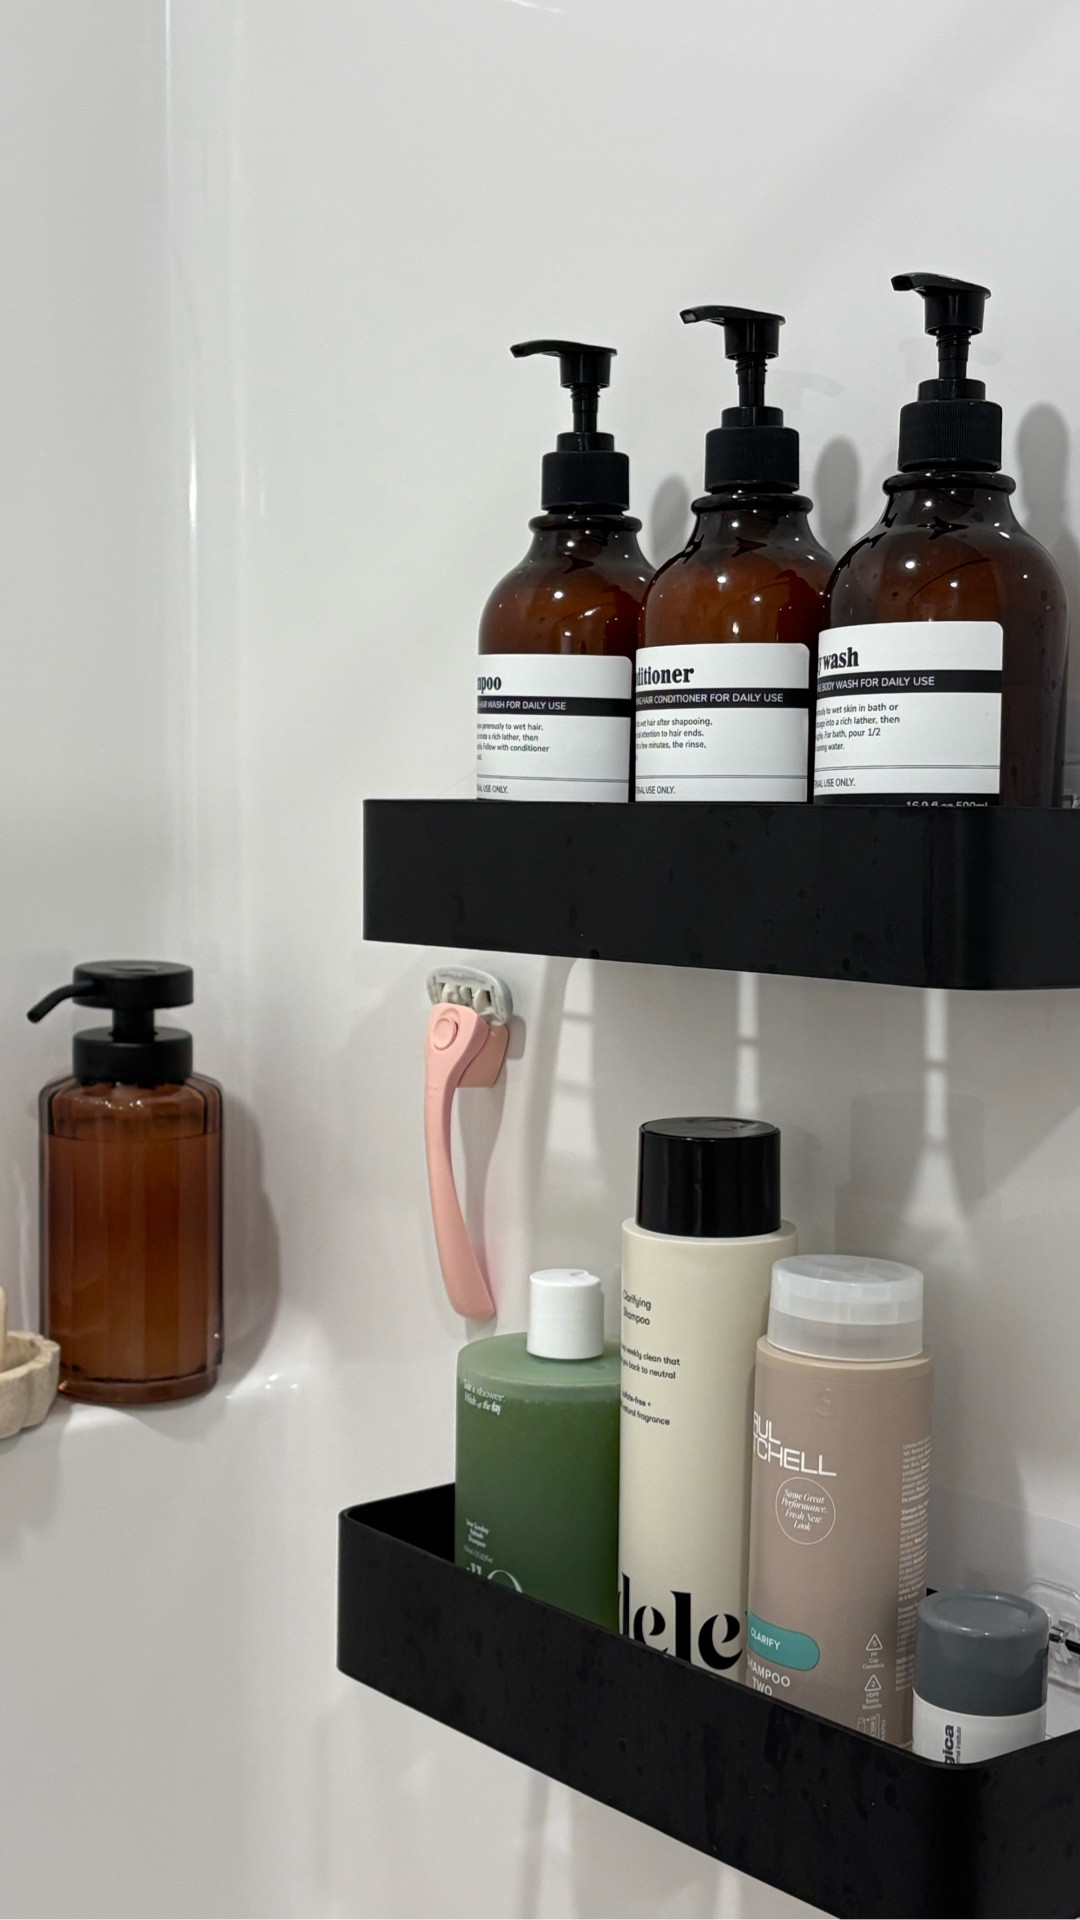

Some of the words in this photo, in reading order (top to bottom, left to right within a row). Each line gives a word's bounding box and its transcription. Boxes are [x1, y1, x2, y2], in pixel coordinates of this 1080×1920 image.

[823, 646, 859, 671] wash
[836, 678, 859, 690] WASH
[860, 677, 880, 688] FOR
[881, 676, 911, 687] DAILY
[913, 676, 935, 687] USE
[654, 693, 707, 704] CONDITIONER
[709, 693, 730, 702] FOR
[732, 693, 761, 702] DAILY
[763, 693, 784, 702] USE
[488, 700, 505, 709] WASH
[506, 701, 521, 709] FOR
[522, 701, 546, 710] DAILY
[548, 701, 567, 711] USE
[832, 706, 842, 714] wet
[843, 704, 857, 714] skin
[858, 704, 866, 712] in
[867, 703, 887, 712] bath
[656, 718, 670, 726] after
[840, 717, 852, 725] rich
[880, 715, 900, 724] then
[513, 723, 526, 731] wet
[669, 728, 682, 737] hair
[522, 733, 539, 741] then
[848, 730, 865, 739] pour
[867, 727, 881, 737] 1/2
[510, 744, 550, 752] conditioner
[672, 740, 684, 748] the
[823, 779, 835, 787] USE
[835, 778, 856, 787] ONLY.
[656, 785, 676, 794] ONLY.
[642, 1352, 661, 1363] clean
[663, 1356, 681, 1366] that
[641, 1365, 648, 1375] to
[649, 1368, 676, 1379] neutral
[621, 1390, 646, 1407] ulfate-free
[636, 1409, 670, 1426] fragrance
[784, 1488, 802, 1501] Same
[803, 1493, 825, 1504] Great
[785, 1509, 805, 1521] Fresh
[806, 1513, 822, 1523] New
[793, 1520, 812, 1531] Look
[750, 1627, 781, 1650] CLARIFY
[752, 1676, 773, 1696] TWO
